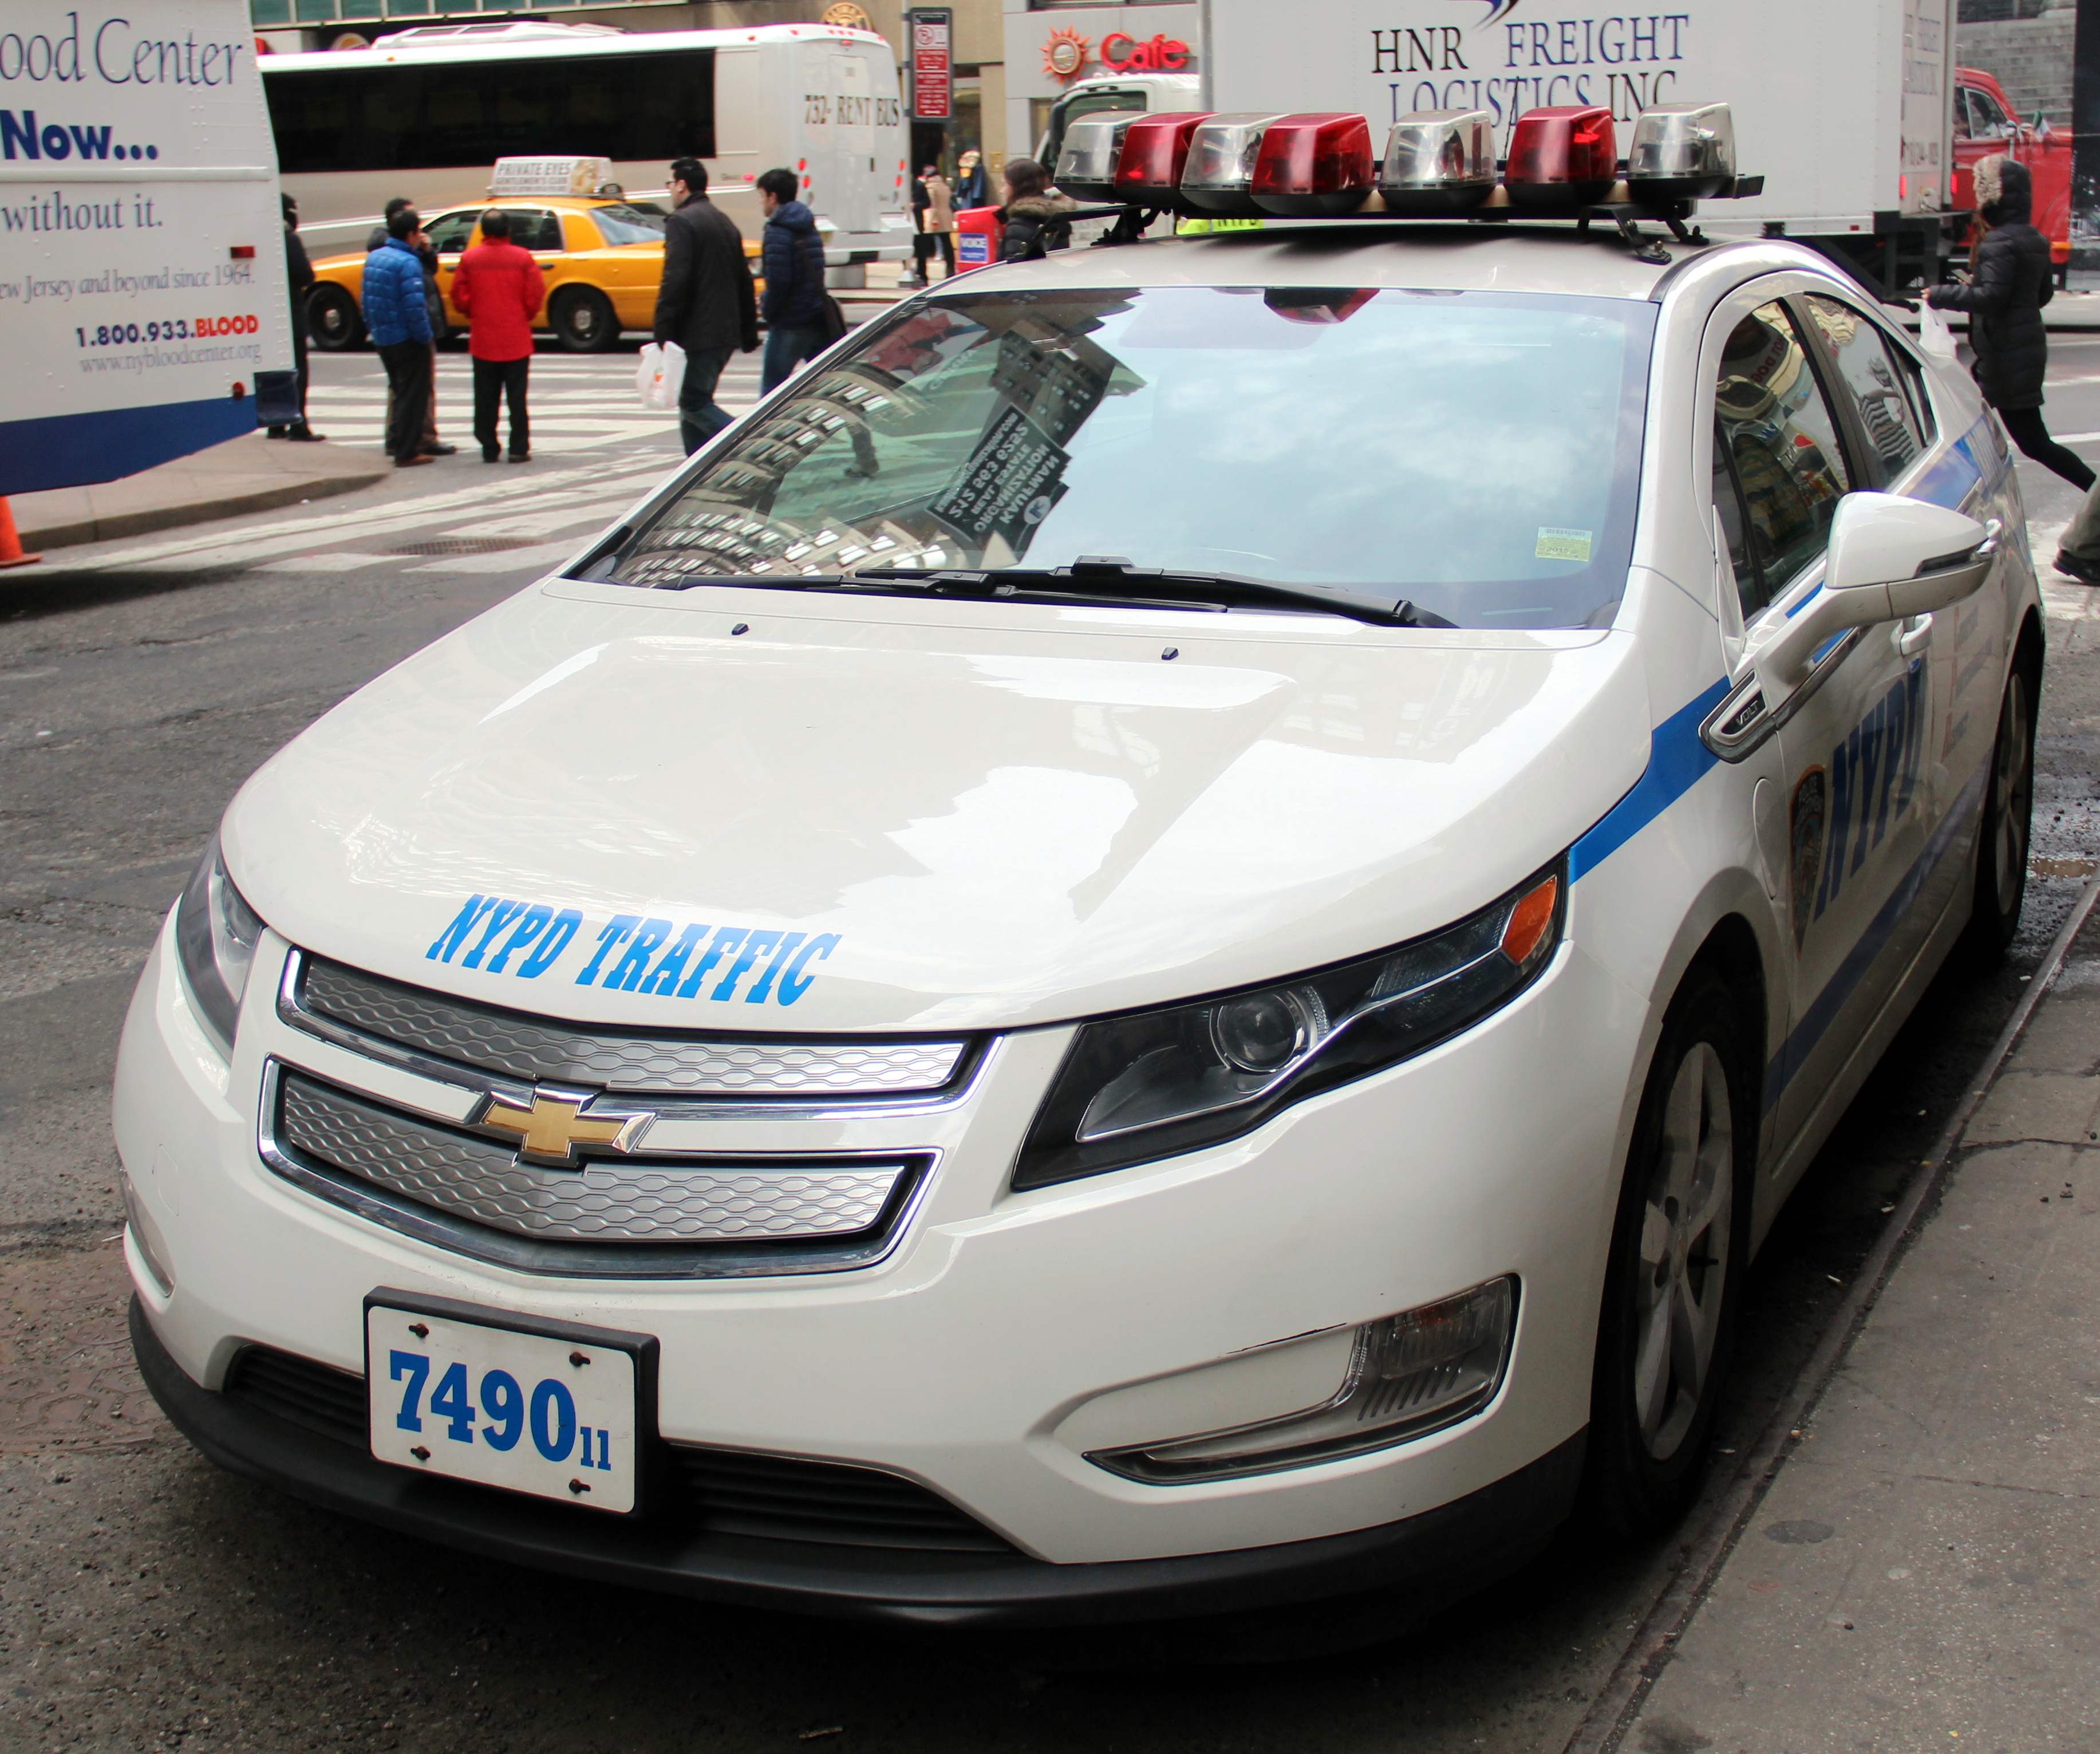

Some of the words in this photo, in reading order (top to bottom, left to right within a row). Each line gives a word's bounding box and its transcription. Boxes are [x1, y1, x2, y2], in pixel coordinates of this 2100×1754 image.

[96, 18, 243, 85] Center
[1102, 33, 1189, 70] Cafe
[1371, 26, 1469, 73] HNR
[1505, 15, 1689, 67] FREIGHT
[837, 96, 870, 126] RENT
[877, 98, 899, 127] BUS
[1388, 74, 1590, 129] LOGISTICS
[0, 109, 159, 160] Now...
[498, 162, 543, 176] PRIVATE
[544, 162, 572, 176] EYES
[1, 191, 125, 232] without
[133, 192, 163, 228] it.
[0, 282, 22, 300] ew
[23, 274, 75, 303] Jersey
[80, 269, 112, 294] and
[112, 265, 170, 298] beyond
[173, 265, 210, 288] since
[76, 314, 259, 348] 1.800.933.BLOOD
[79, 344, 262, 374] www.nybloodcenter.org
[1735, 700, 1758, 726] VOLT
[1813, 657, 1922, 924] NYPD
[425, 893, 583, 979] NYPD
[574, 915, 843, 1006] TRAFFIC
[390, 1349, 576, 1462] 7490
